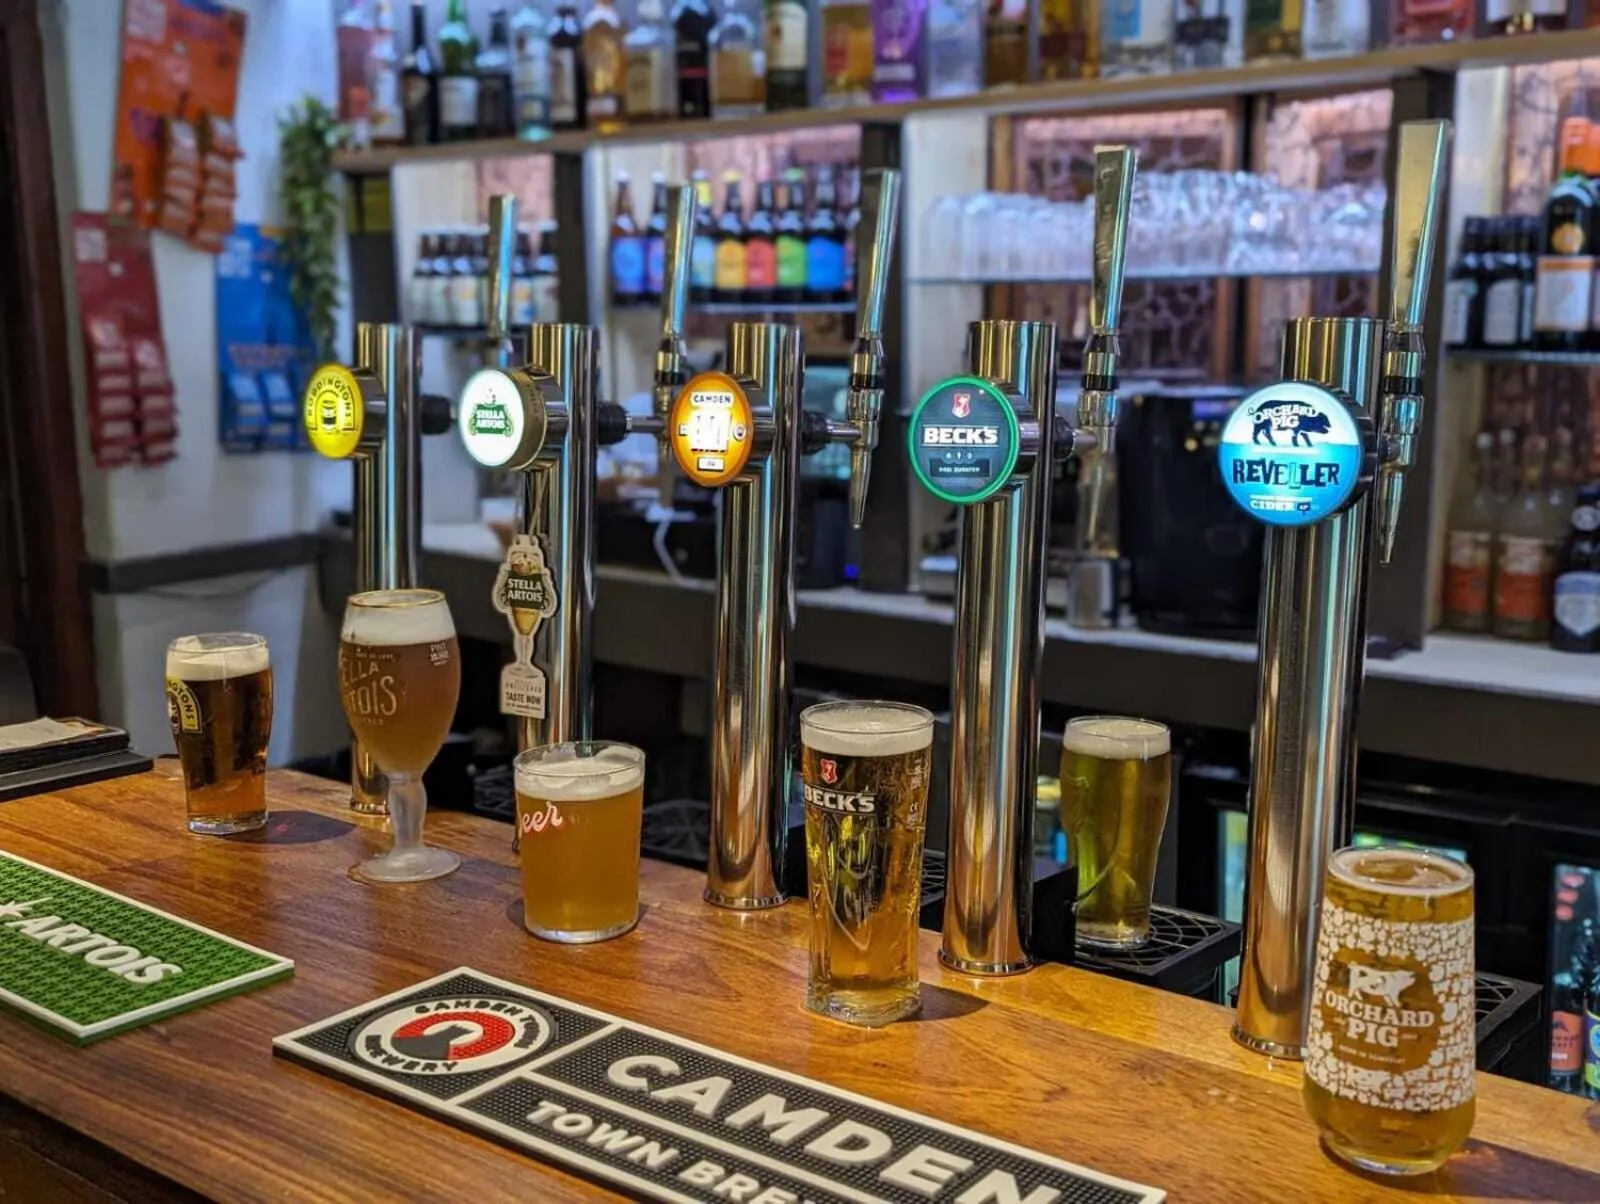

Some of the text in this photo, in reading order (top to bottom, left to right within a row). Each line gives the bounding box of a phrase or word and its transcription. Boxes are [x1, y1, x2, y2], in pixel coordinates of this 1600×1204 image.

[693, 394, 731, 403] CAMDEN
[476, 409, 506, 419] STELLA
[1252, 404, 1318, 424] ORCHARD
[1271, 415, 1299, 430] PIG
[923, 426, 998, 444] BECK'S
[1232, 457, 1340, 489] REVELLER
[1250, 500, 1295, 512] CIDER
[507, 578, 542, 592] STELLA
[507, 589, 543, 602] ARTOIS
[506, 691, 541, 705] TASTE NOW
[804, 784, 875, 813] BECK'S
[518, 801, 564, 839] eer
[4, 915, 183, 984] ARTOIS
[1325, 990, 1435, 1028] ORCHARD
[1346, 1017, 1399, 1048] PIG
[526, 1100, 680, 1169] TOWN
[606, 1054, 1062, 1204] CAMDEN
